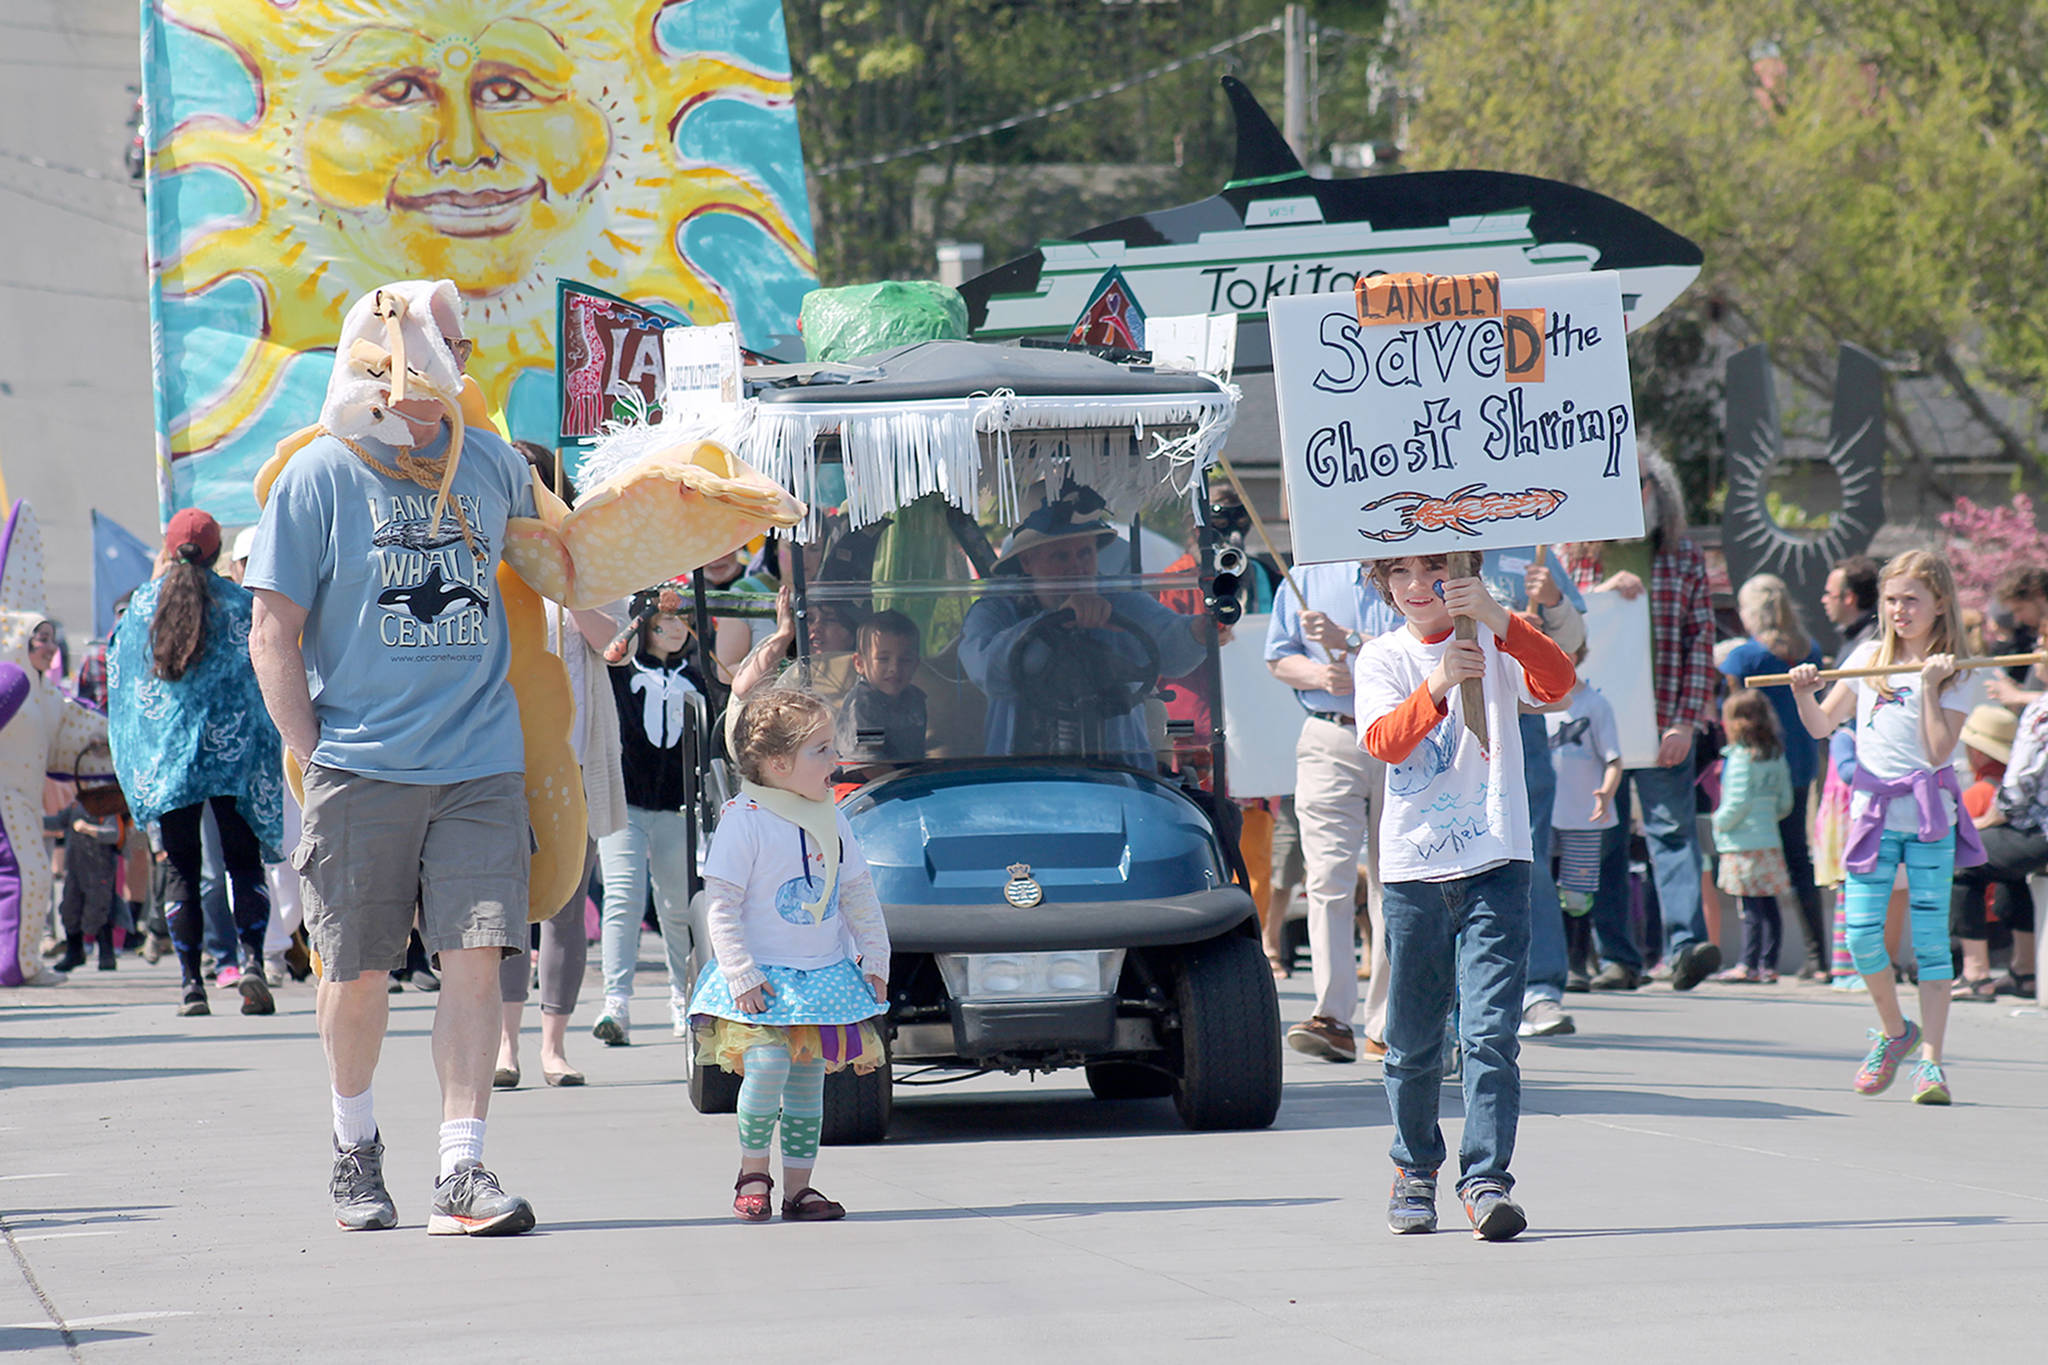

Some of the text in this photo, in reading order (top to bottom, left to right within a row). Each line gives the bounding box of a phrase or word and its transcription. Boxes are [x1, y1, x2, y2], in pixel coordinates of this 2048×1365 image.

[1200, 263, 1389, 313] Tokita
[1359, 276, 1500, 320] LANGLEY
[1545, 311, 1602, 357] the
[1305, 386, 1629, 487] Ghost Shrimp
[375, 548, 490, 599] WHALE
[380, 608, 488, 648] CENTER
